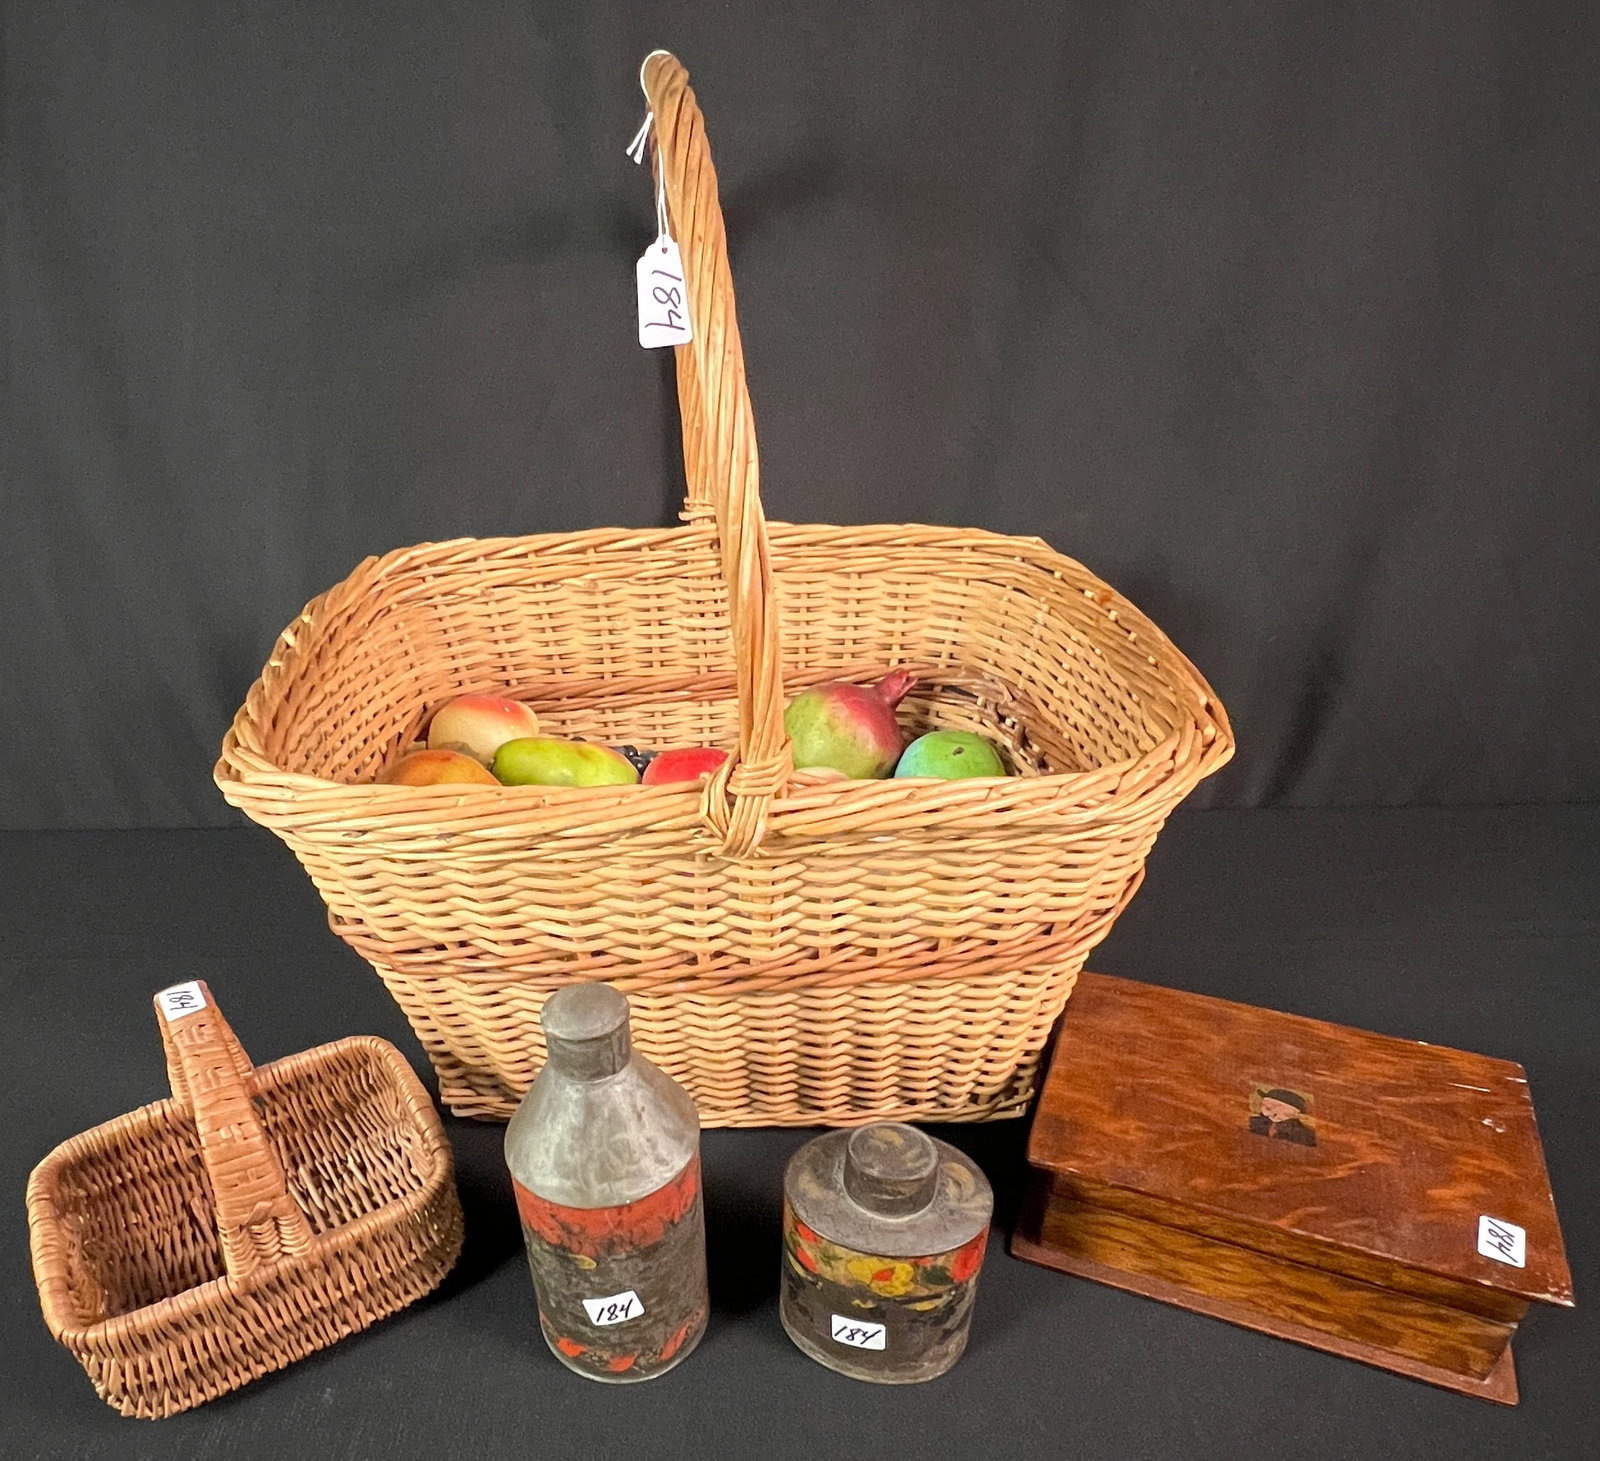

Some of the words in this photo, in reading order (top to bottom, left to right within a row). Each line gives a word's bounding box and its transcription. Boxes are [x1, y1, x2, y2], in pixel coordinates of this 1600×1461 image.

[644, 269, 685, 331] 184
[166, 990, 199, 1011] 184
[1485, 1219, 1519, 1264] 184
[596, 1298, 634, 1323] 184
[834, 1325, 882, 1345] 184
